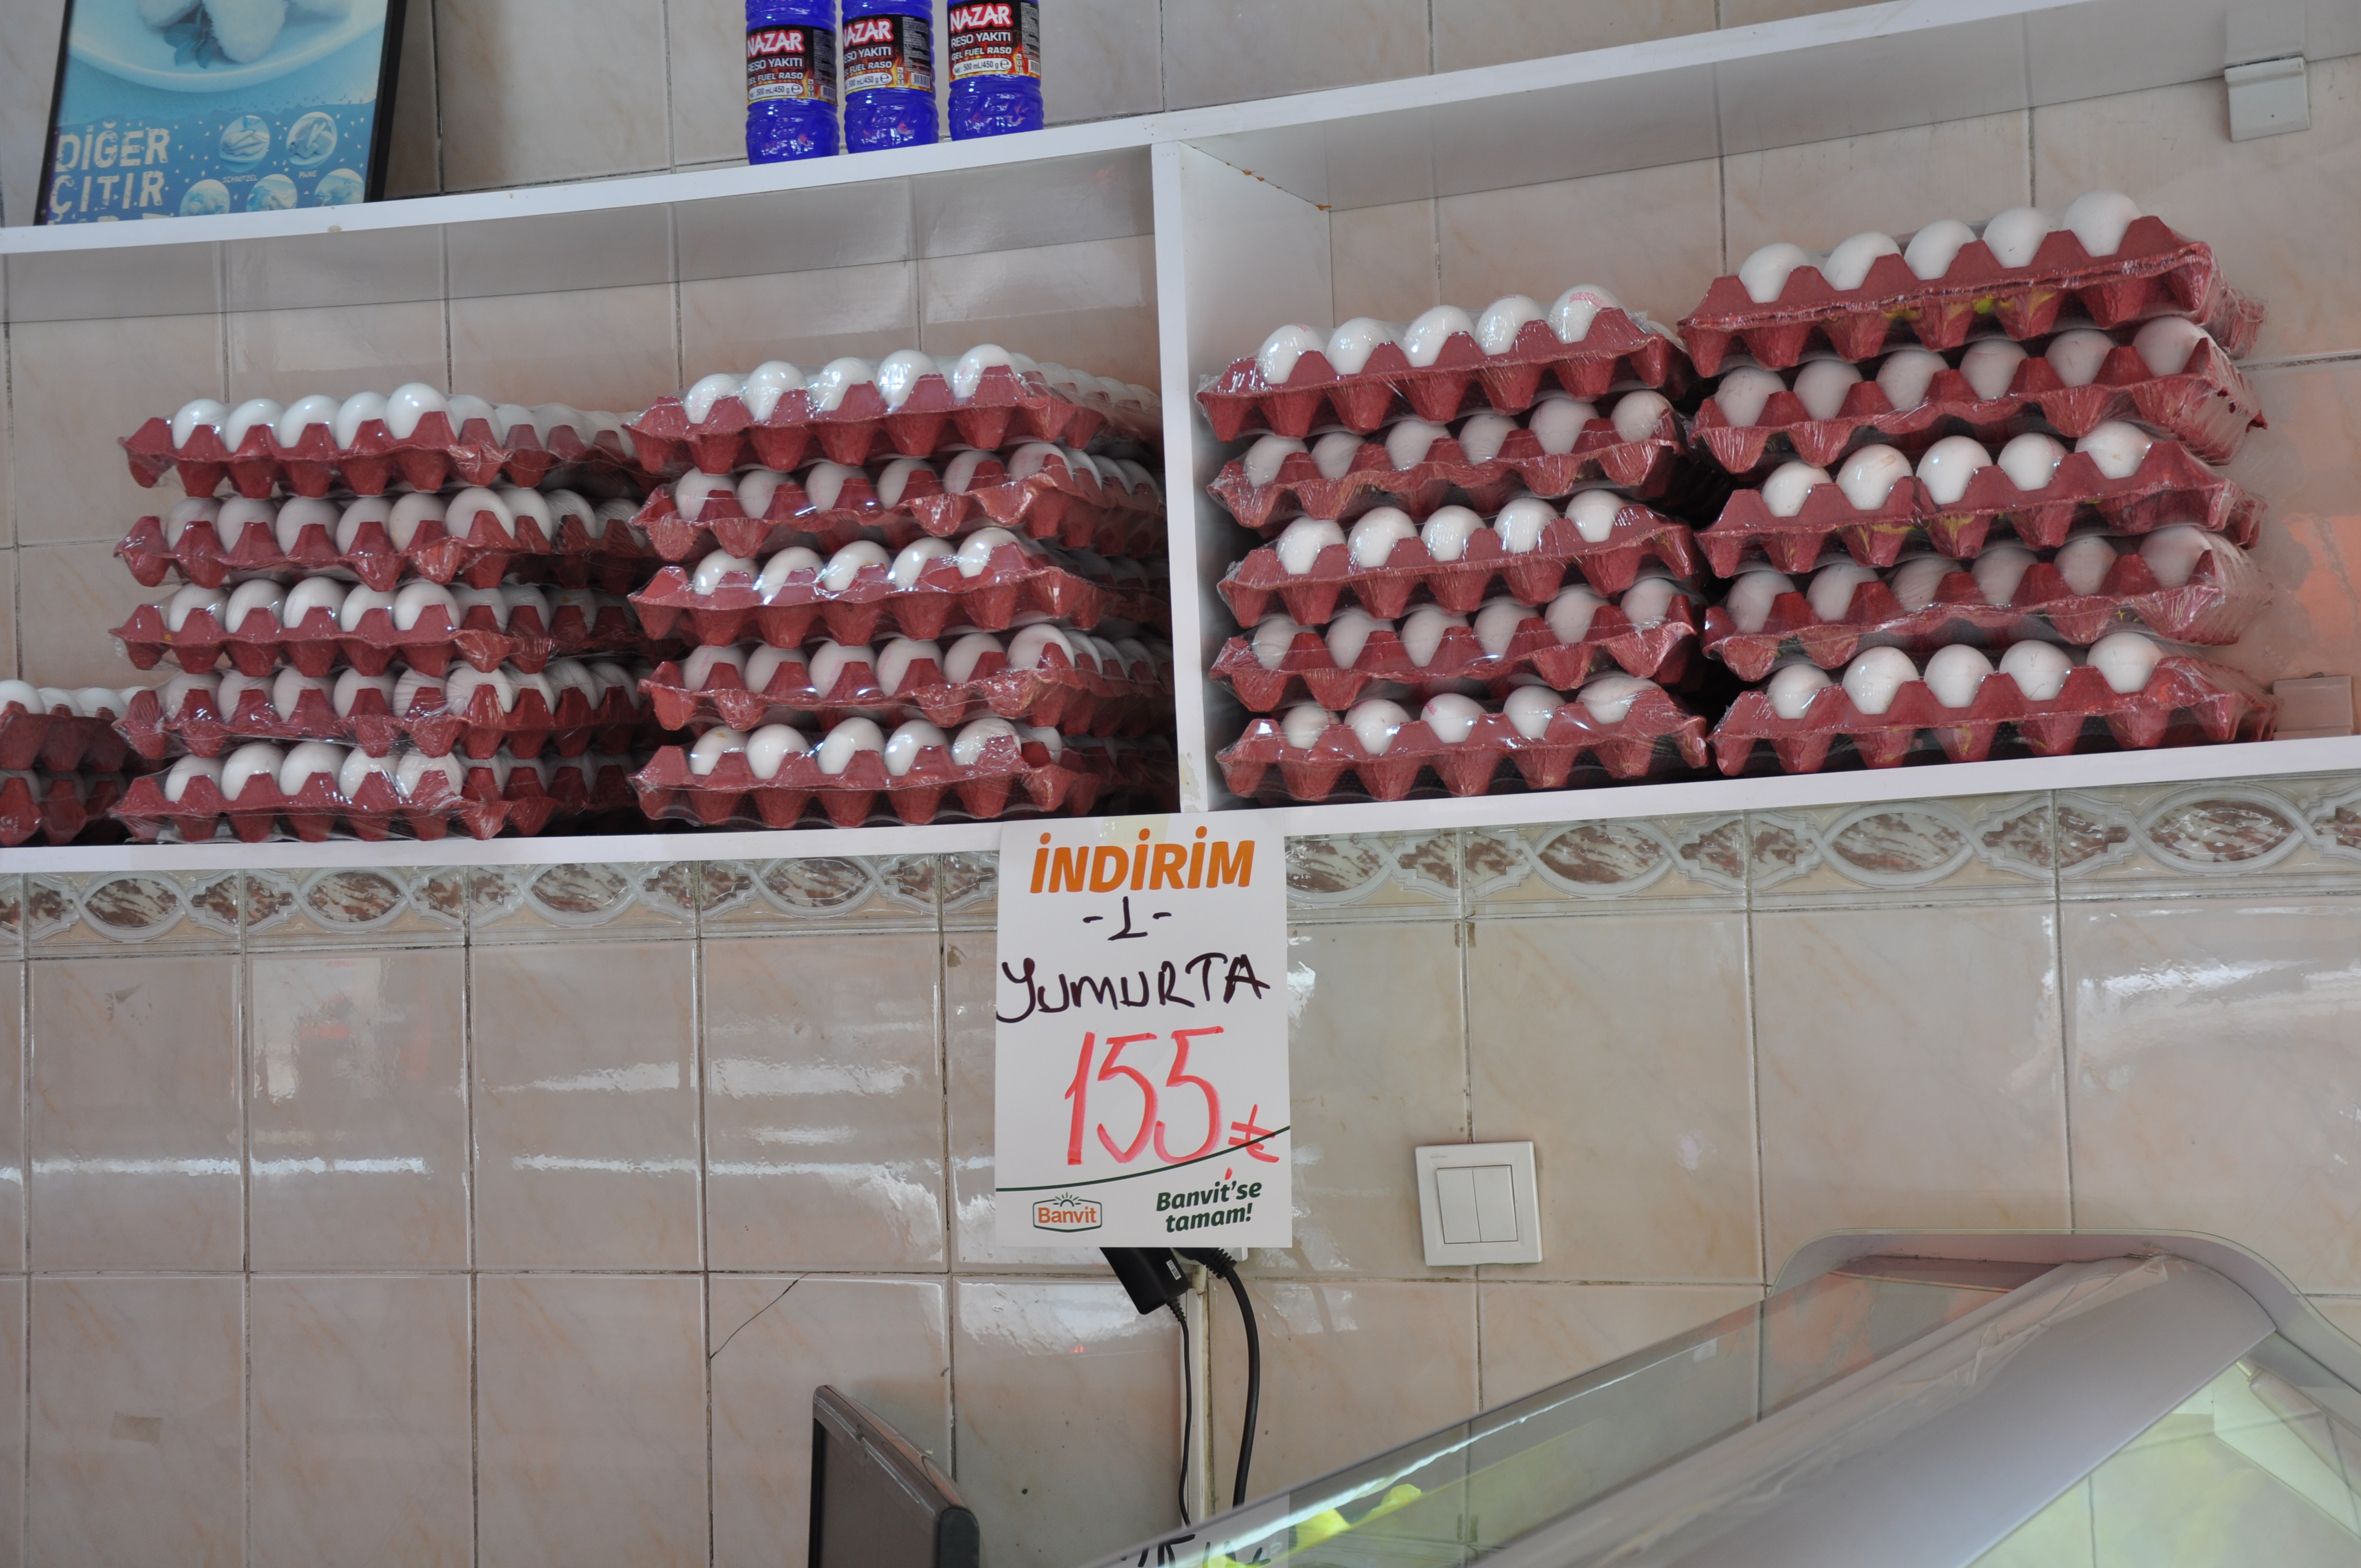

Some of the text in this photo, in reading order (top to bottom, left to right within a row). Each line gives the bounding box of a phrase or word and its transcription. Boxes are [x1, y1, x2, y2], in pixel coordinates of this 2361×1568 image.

[950, 6, 1011, 31] NAZAR
[951, 31, 1011, 48] RESO YAKITI
[858, 47, 891, 58] YAKITI
[951, 52, 963, 61] GEL
[965, 47, 984, 57] FUEL
[768, 57, 803, 67] YAKITI
[850, 64, 866, 73] FUEL
[758, 73, 776, 82] FUEL
[55, 122, 170, 172] DİĞER
[222, 174, 258, 183] SCHNITZEL
[298, 170, 317, 178] PANE
[50, 171, 165, 221] ÇITIR
[1030, 826, 1255, 894] İNDİRİM
[996, 952, 1270, 1023] YUMURTA
[1156, 1180, 1262, 1211] Banvit'se
[1037, 1206, 1097, 1223] Banvit
[1166, 1203, 1253, 1233] tamam!
